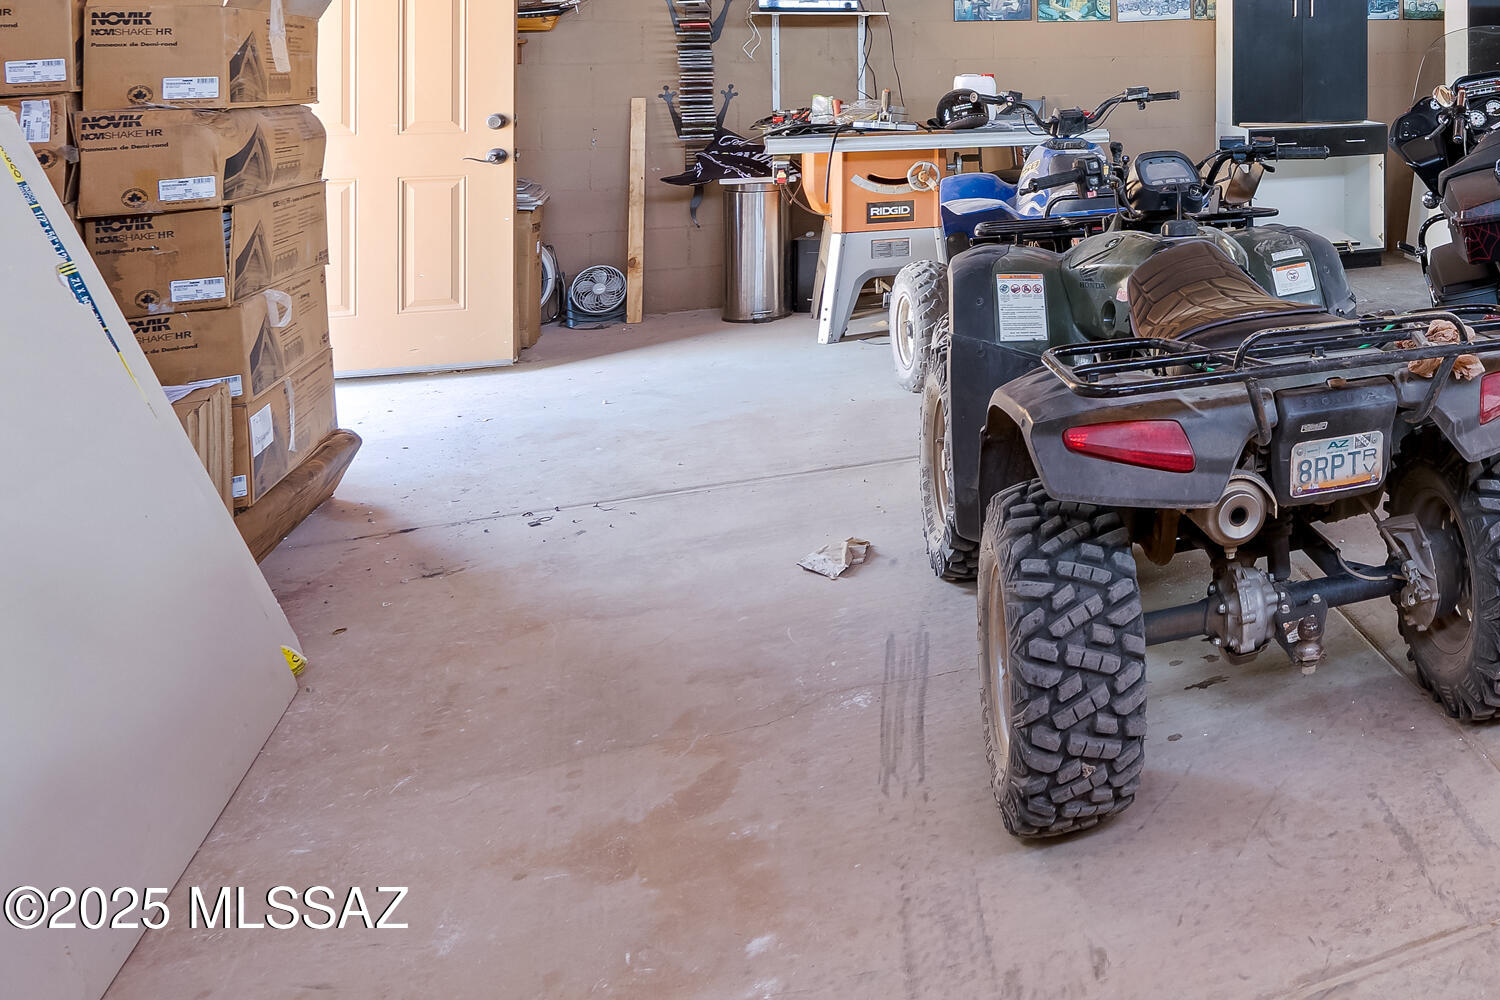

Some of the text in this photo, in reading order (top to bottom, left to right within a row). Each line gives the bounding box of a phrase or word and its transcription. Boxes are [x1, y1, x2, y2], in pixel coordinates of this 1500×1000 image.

[91, 11, 152, 26] NOVIK
[156, 28, 172, 36] HR
[81, 114, 143, 130] NOVIK
[146, 129, 163, 137] HR
[131, 142, 169, 150] Demi-rond
[870, 205, 911, 216] RIDGID
[95, 216, 154, 234] NOVIK
[158, 230, 175, 239] HR
[1080, 281, 1106, 290] HONDA
[128, 317, 172, 335] OVIK
[135, 331, 192, 345] SHAKE HR
[1327, 439, 1349, 450] AZ
